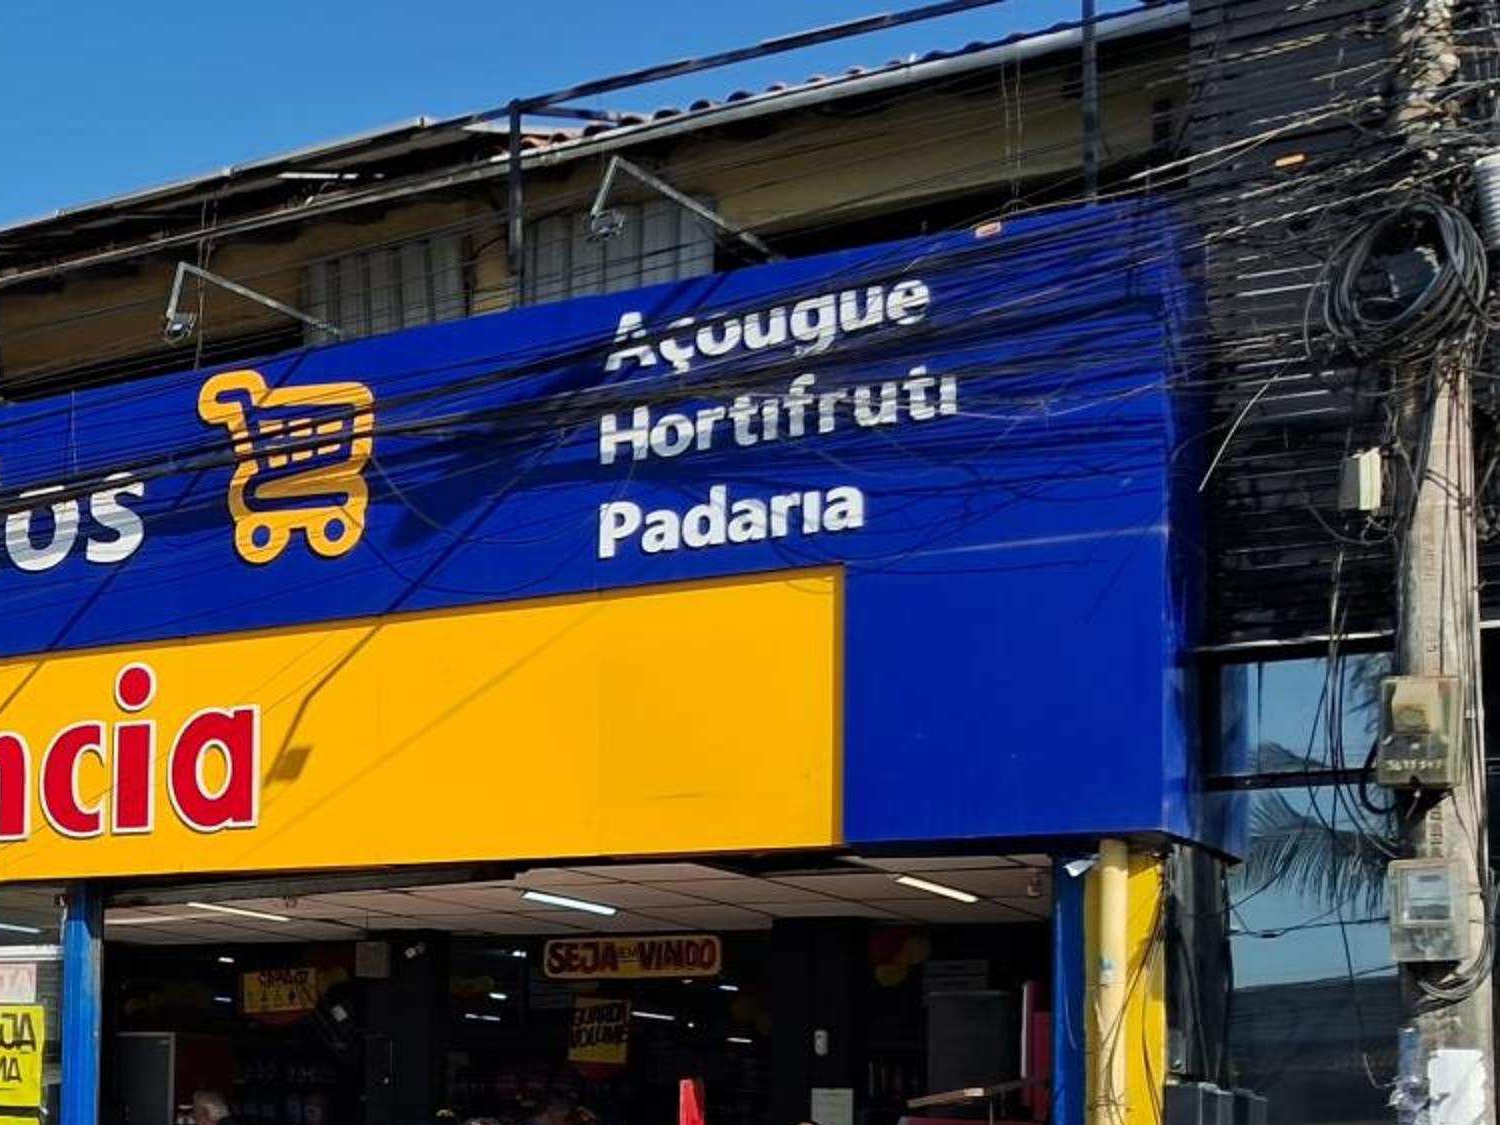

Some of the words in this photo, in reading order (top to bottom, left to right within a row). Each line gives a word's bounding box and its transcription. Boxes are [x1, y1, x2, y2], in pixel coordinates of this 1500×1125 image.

[604, 279, 932, 374] Açougue
[600, 365, 958, 465] Hortifruti
[597, 484, 865, 559] Padaria
